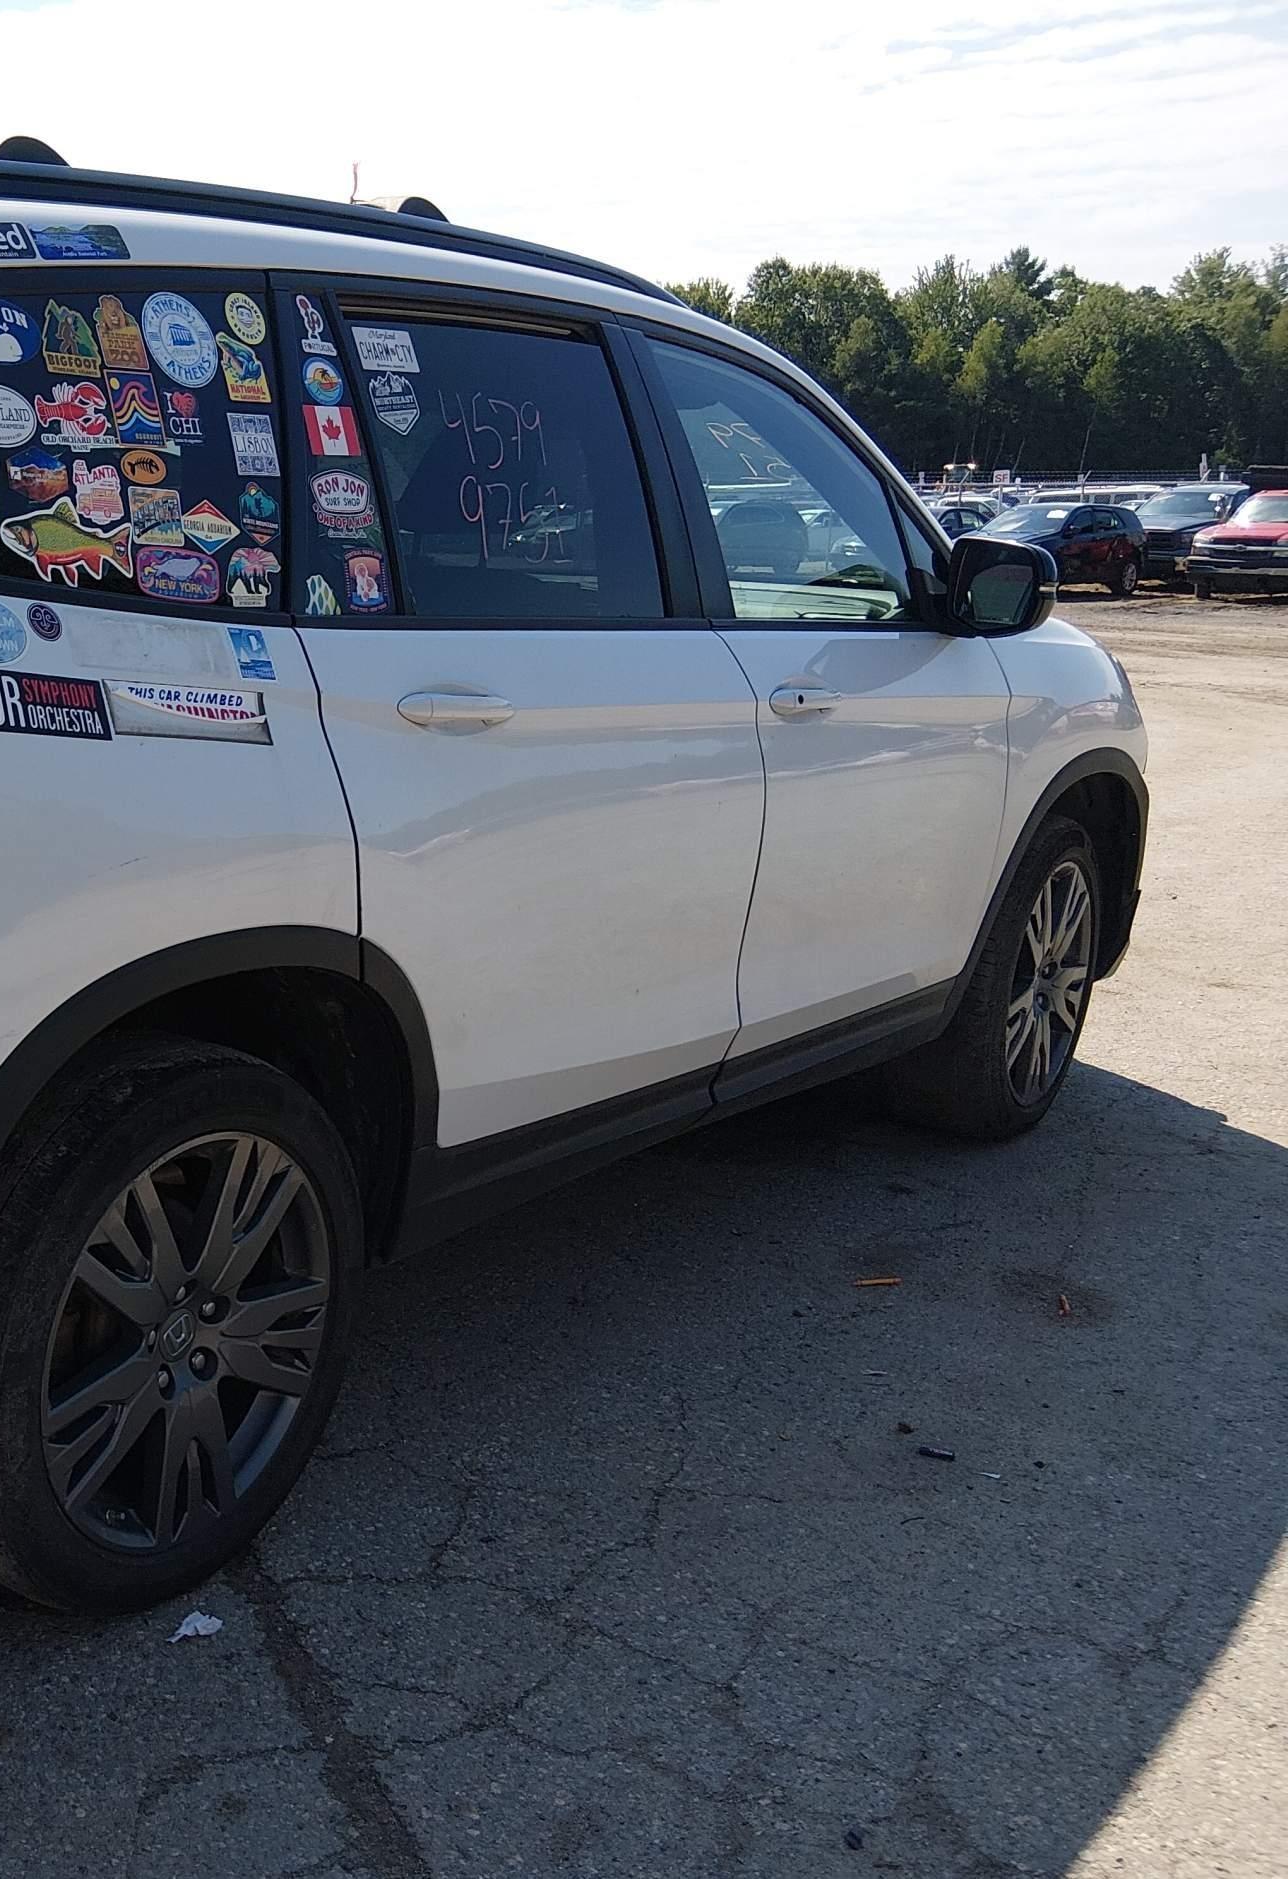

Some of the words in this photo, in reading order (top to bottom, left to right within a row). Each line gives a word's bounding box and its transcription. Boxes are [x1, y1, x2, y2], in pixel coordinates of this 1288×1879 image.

[152, 300, 191, 319] ATHENS
[47, 354, 98, 370] BIGFOOT
[167, 356, 211, 380] ATHENS
[0, 407, 30, 422] LAND
[169, 417, 203, 436] CHI
[438, 389, 546, 469] 4579
[233, 435, 276, 454] LISBON
[73, 466, 118, 487] ATLANTA
[316, 477, 339, 498] RON
[342, 477, 365, 497] JON
[324, 497, 341, 506] SURF
[343, 497, 360, 506] SHOP
[184, 519, 205, 531] GEORGIA
[207, 521, 232, 534] AQUARIUM
[317, 512, 335, 527] ONE
[155, 579, 176, 591] NEW
[179, 581, 204, 593] YORK
[22, 678, 97, 708] SYMPHONY
[127, 685, 155, 700] THIS
[158, 689, 182, 702] CAR
[186, 691, 243, 707] CLIMBED
[27, 704, 104, 736] ORCHESTRA
